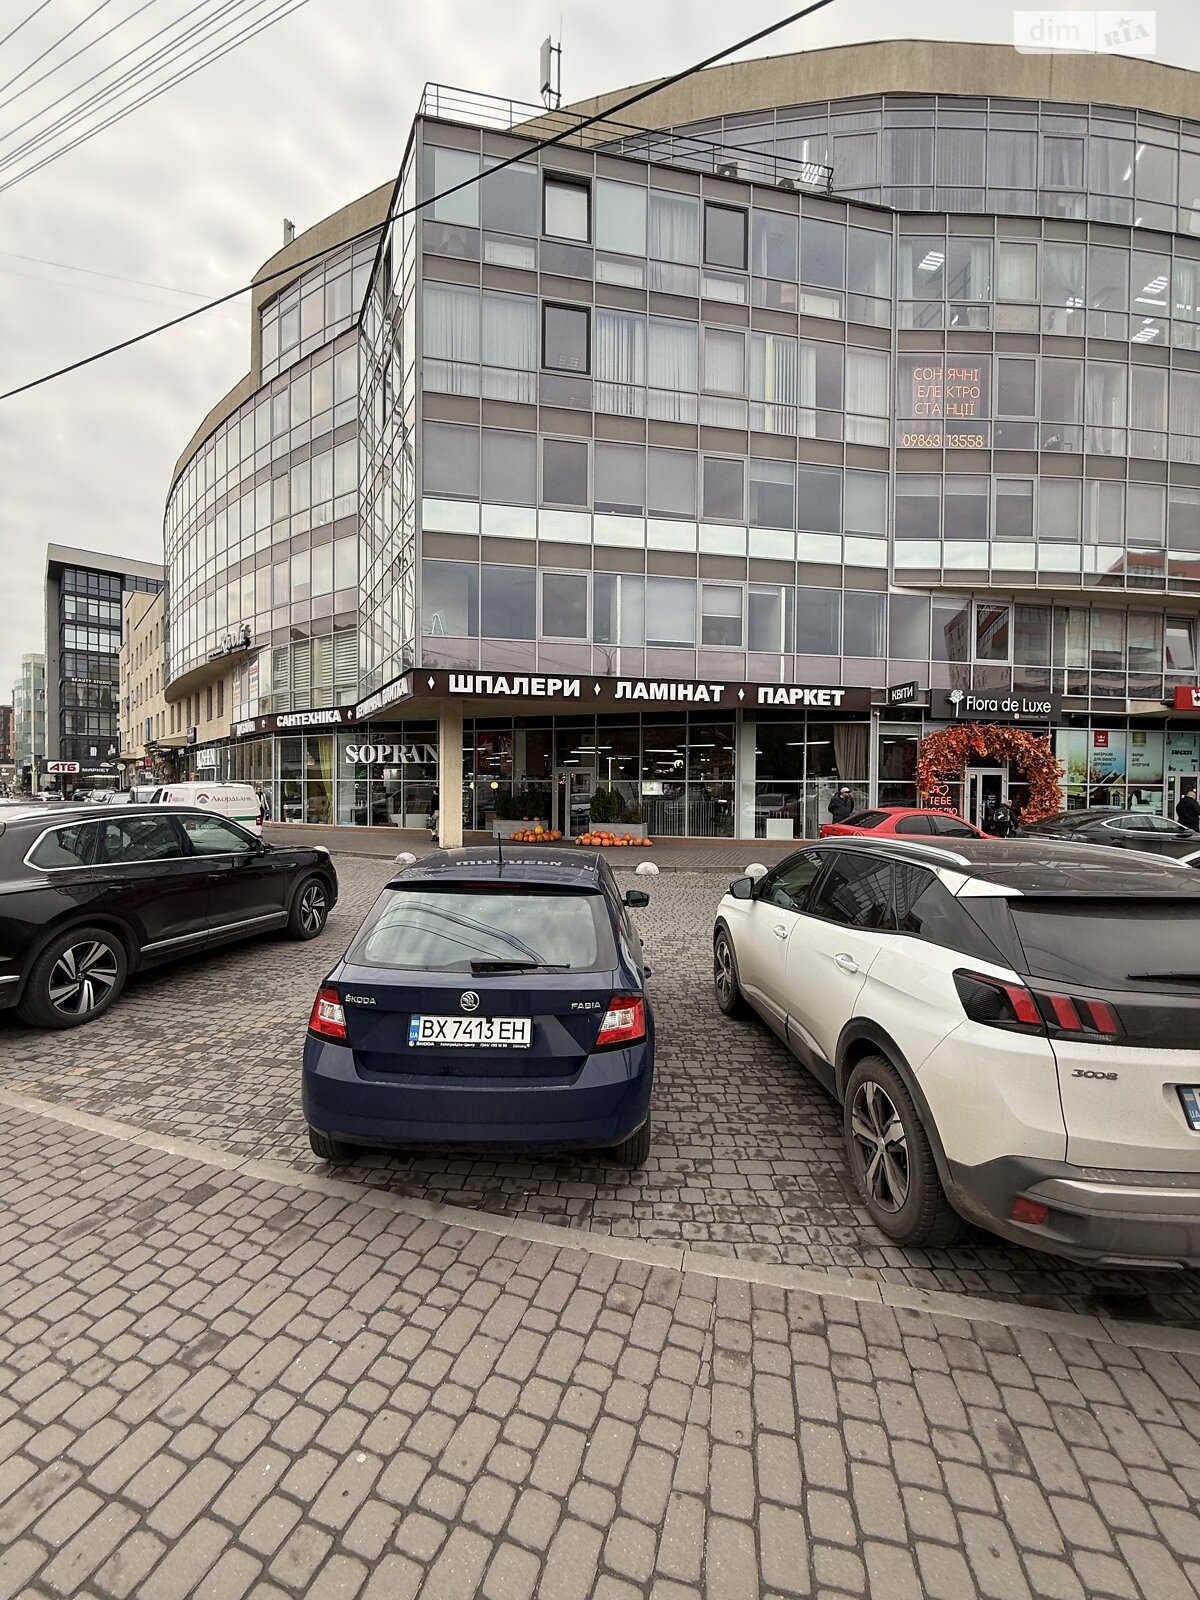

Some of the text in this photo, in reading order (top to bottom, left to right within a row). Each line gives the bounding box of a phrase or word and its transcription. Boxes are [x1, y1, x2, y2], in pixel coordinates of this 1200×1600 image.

[913, 368, 979, 381] СОНЯЧНІ
[917, 385, 980, 398] ЕЛЕКТРО
[914, 401, 975, 417] СТАНЦІЇ
[448, 674, 846, 706] ШПАЛЕРИ ЛАМІНАТ ПАРКЕТ
[891, 686, 913, 701] КВІТИ
[966, 695, 1051, 713] Flora de Luxe
[276, 710, 342, 727] САНТЕХНІКА
[49, 763, 78, 772] АТБ
[929, 796, 952, 805] ТЕБЕ
[571, 1001, 602, 1010] FABIA
[422, 1019, 525, 1040] BX 7413 EH
[1071, 1069, 1119, 1081] 3008
